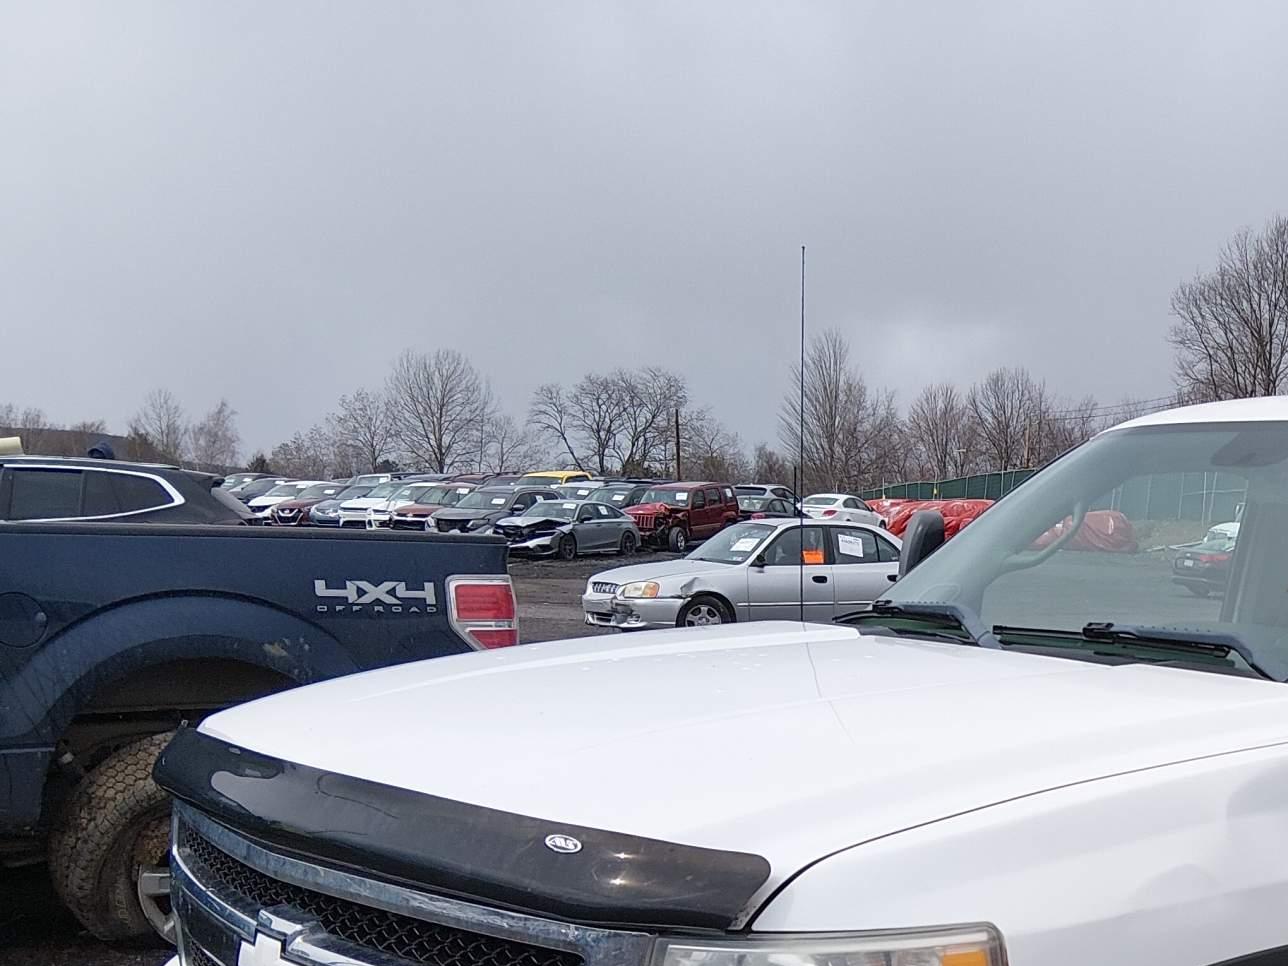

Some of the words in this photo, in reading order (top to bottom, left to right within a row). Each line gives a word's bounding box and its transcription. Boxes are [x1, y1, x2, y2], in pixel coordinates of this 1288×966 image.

[314, 579, 437, 605] 4X4
[316, 605, 362, 613] OFF
[374, 605, 437, 613] ROAD
